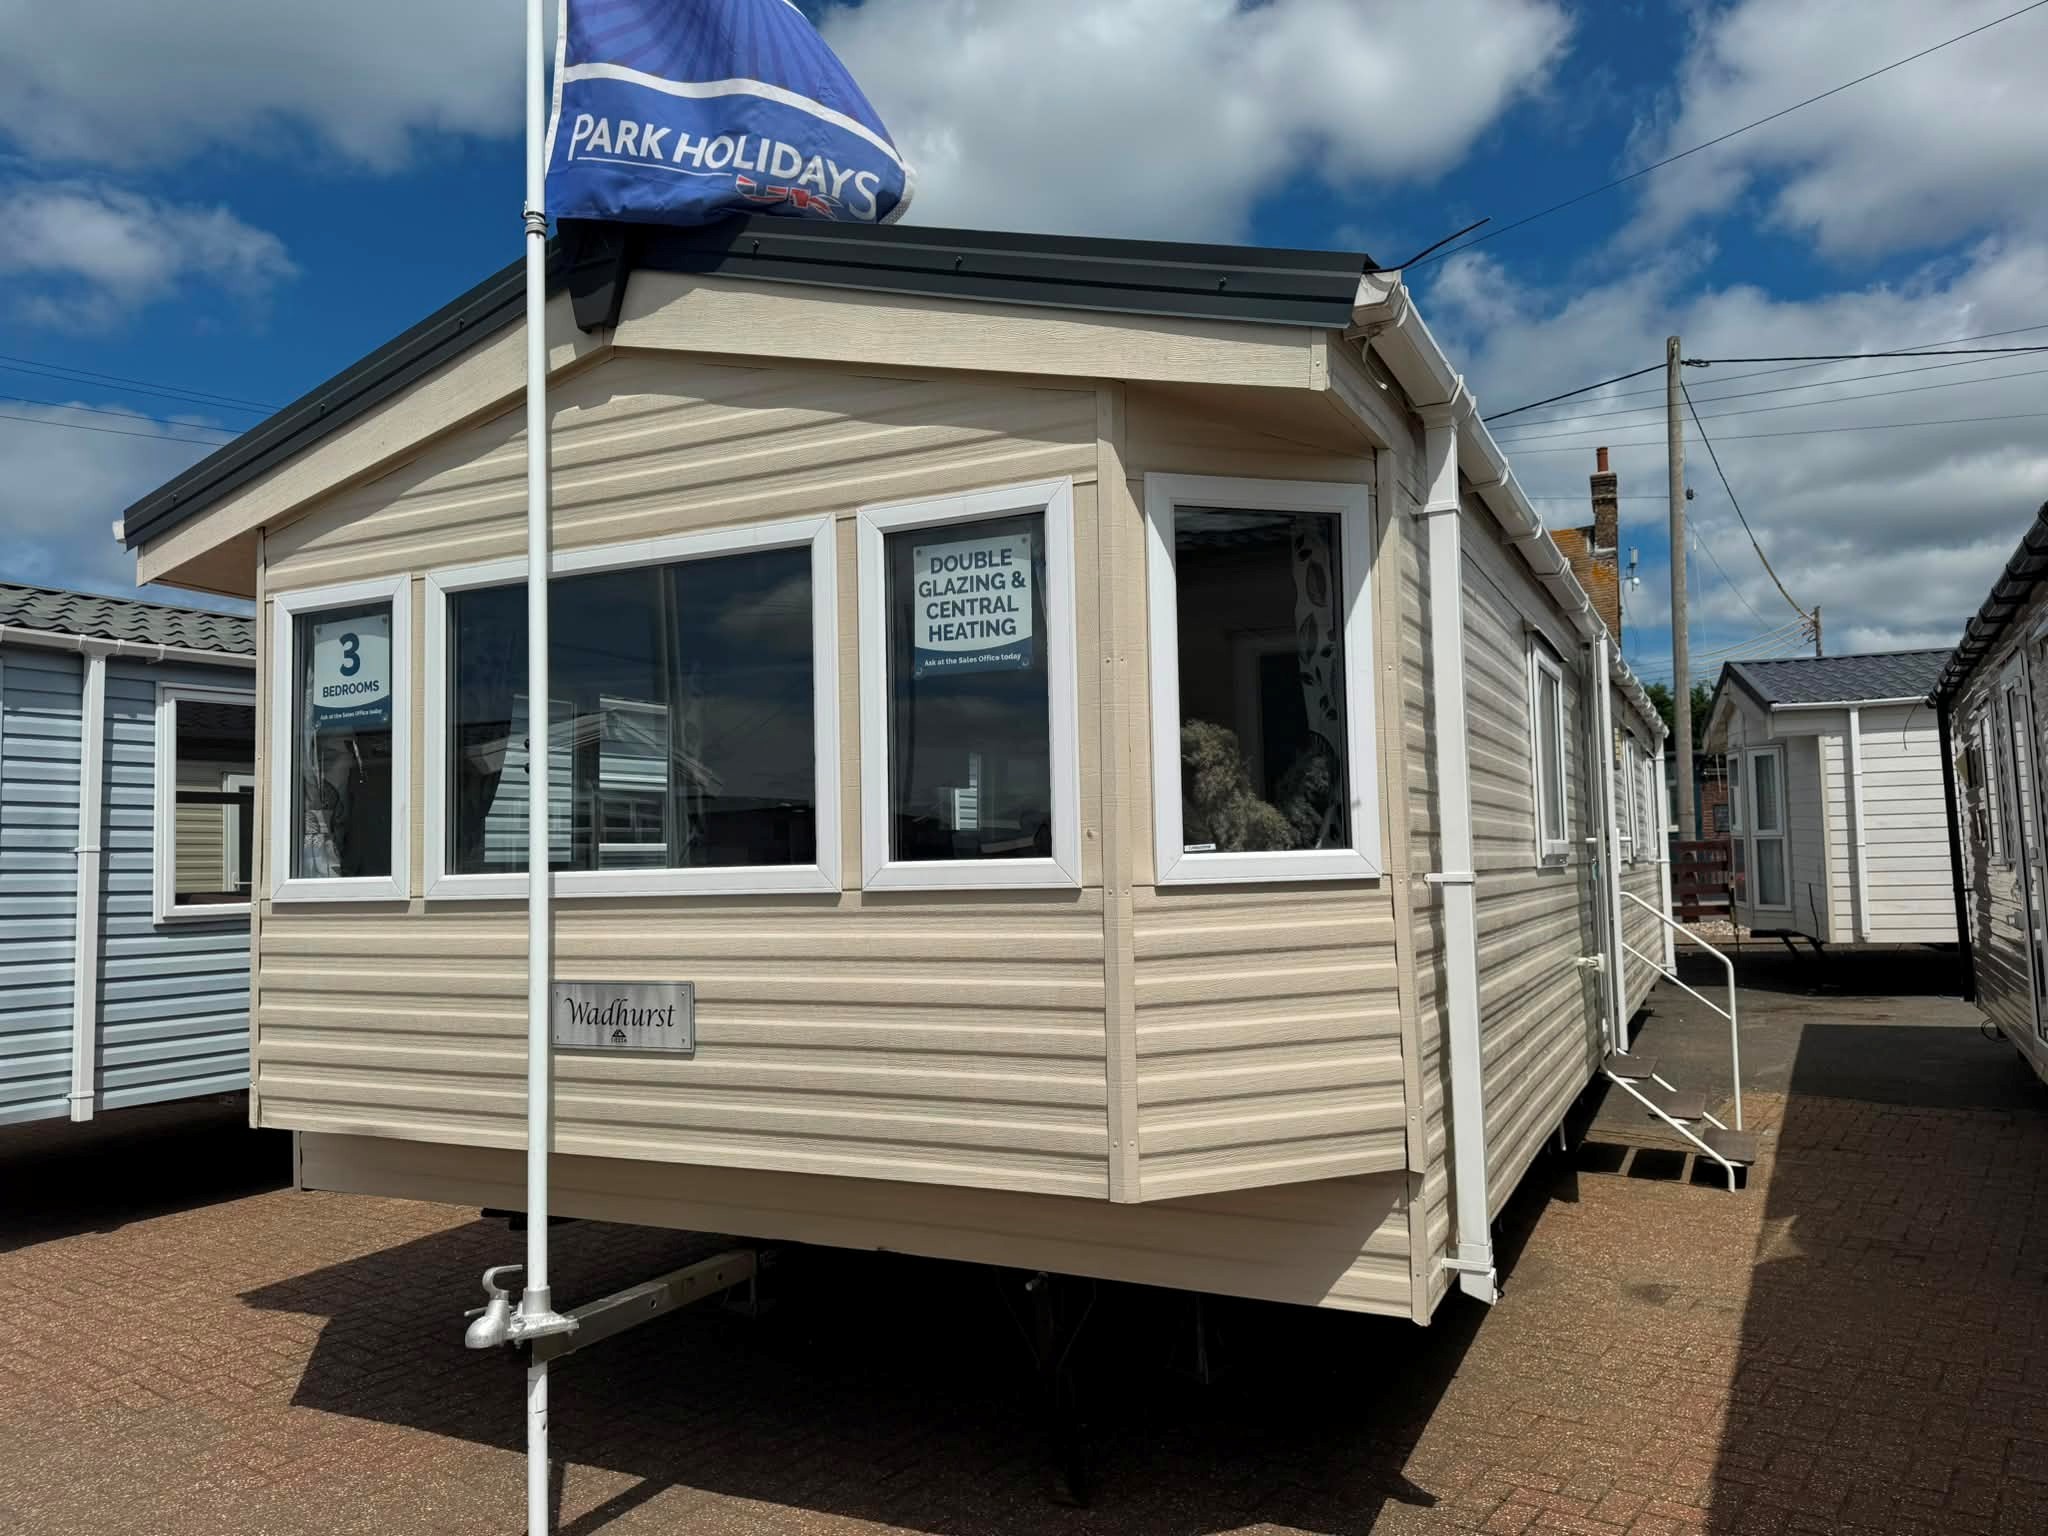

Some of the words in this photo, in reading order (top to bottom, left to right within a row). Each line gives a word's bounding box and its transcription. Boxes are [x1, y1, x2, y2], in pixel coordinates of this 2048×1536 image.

[568, 113, 672, 161] PARK
[672, 133, 880, 220] HOLIDAYS
[930, 548, 1013, 574] DOUBLE
[918, 572, 1006, 598] GLAZING
[1011, 570, 1027, 589] &
[926, 594, 1019, 620] CENTRAL
[928, 618, 1017, 643] HEATING
[339, 632, 361, 677] 3
[924, 659, 937, 667] Ask
[945, 657, 957, 665] the
[958, 656, 978, 664] Sales
[978, 654, 1000, 663] Office
[1000, 652, 1022, 661] today
[322, 680, 380, 698] BEDROOMS
[564, 997, 676, 1028] Wadhurst
